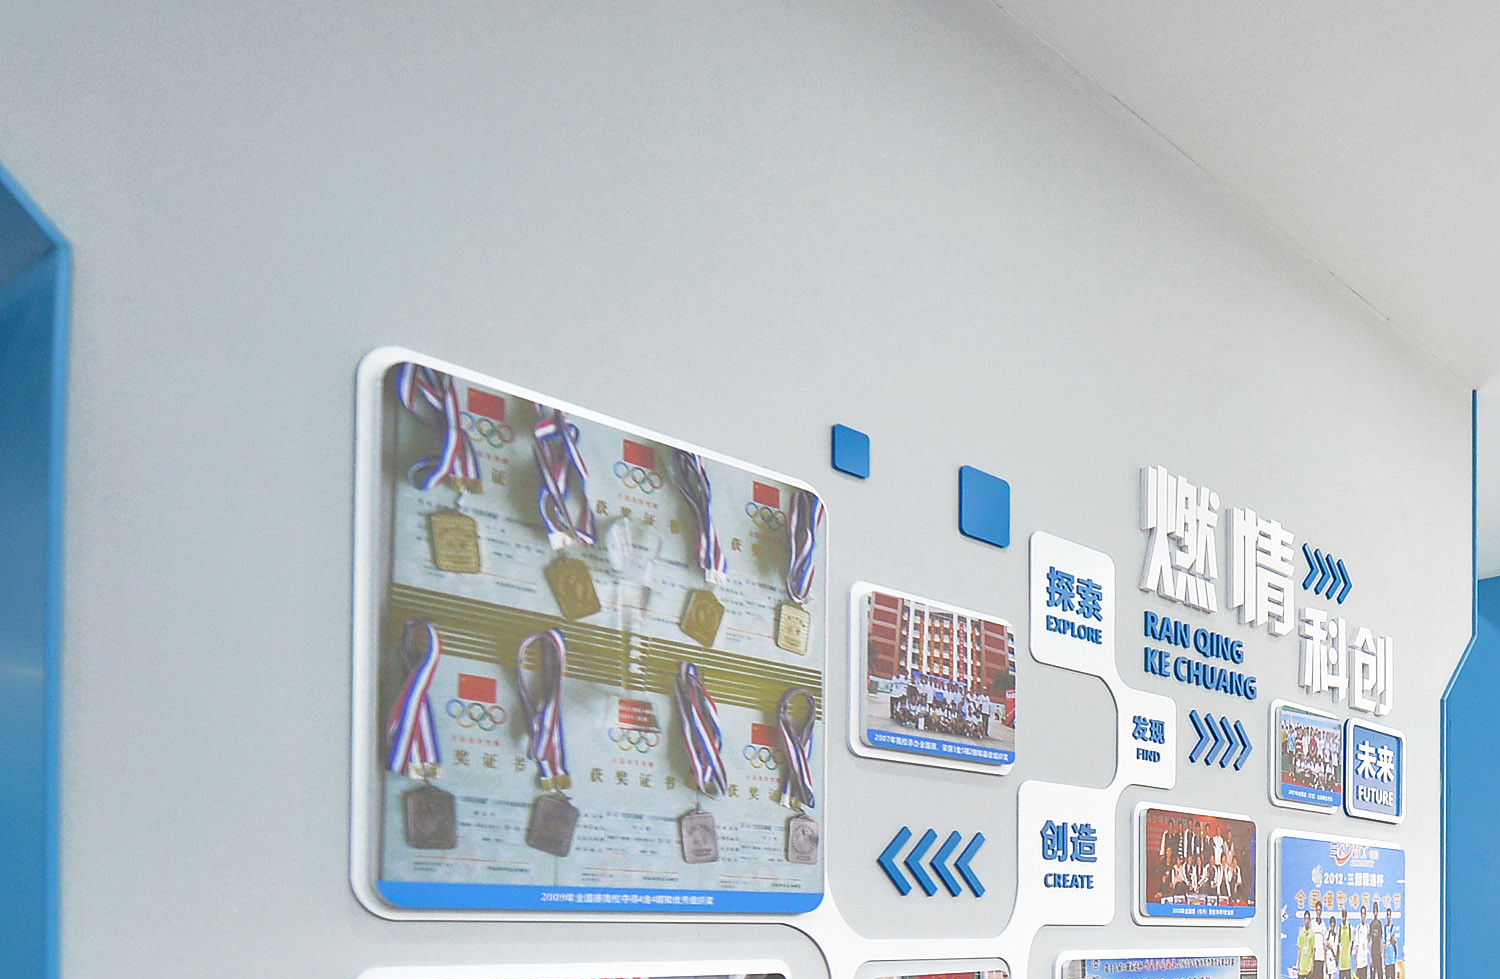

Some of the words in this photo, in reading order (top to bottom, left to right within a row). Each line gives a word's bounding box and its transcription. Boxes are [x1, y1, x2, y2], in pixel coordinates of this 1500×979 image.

[1139, 464, 1296, 636] 燃情
[1046, 566, 1103, 622] 探索
[1046, 615, 1103, 645] EXPLORE
[1144, 610, 1190, 649] RAN
[1194, 629, 1244, 665] QING
[1144, 648, 1171, 678] KE
[1173, 656, 1257, 700] CHUANG
[1299, 606, 1394, 716] 科创
[1132, 715, 1166, 745] 发现
[1136, 747, 1161, 763] FIND
[1355, 739, 1395, 784] 未来
[1357, 784, 1394, 808] FUTURE
[1040, 819, 1098, 863] 创造
[1044, 873, 1095, 890] CREATE
